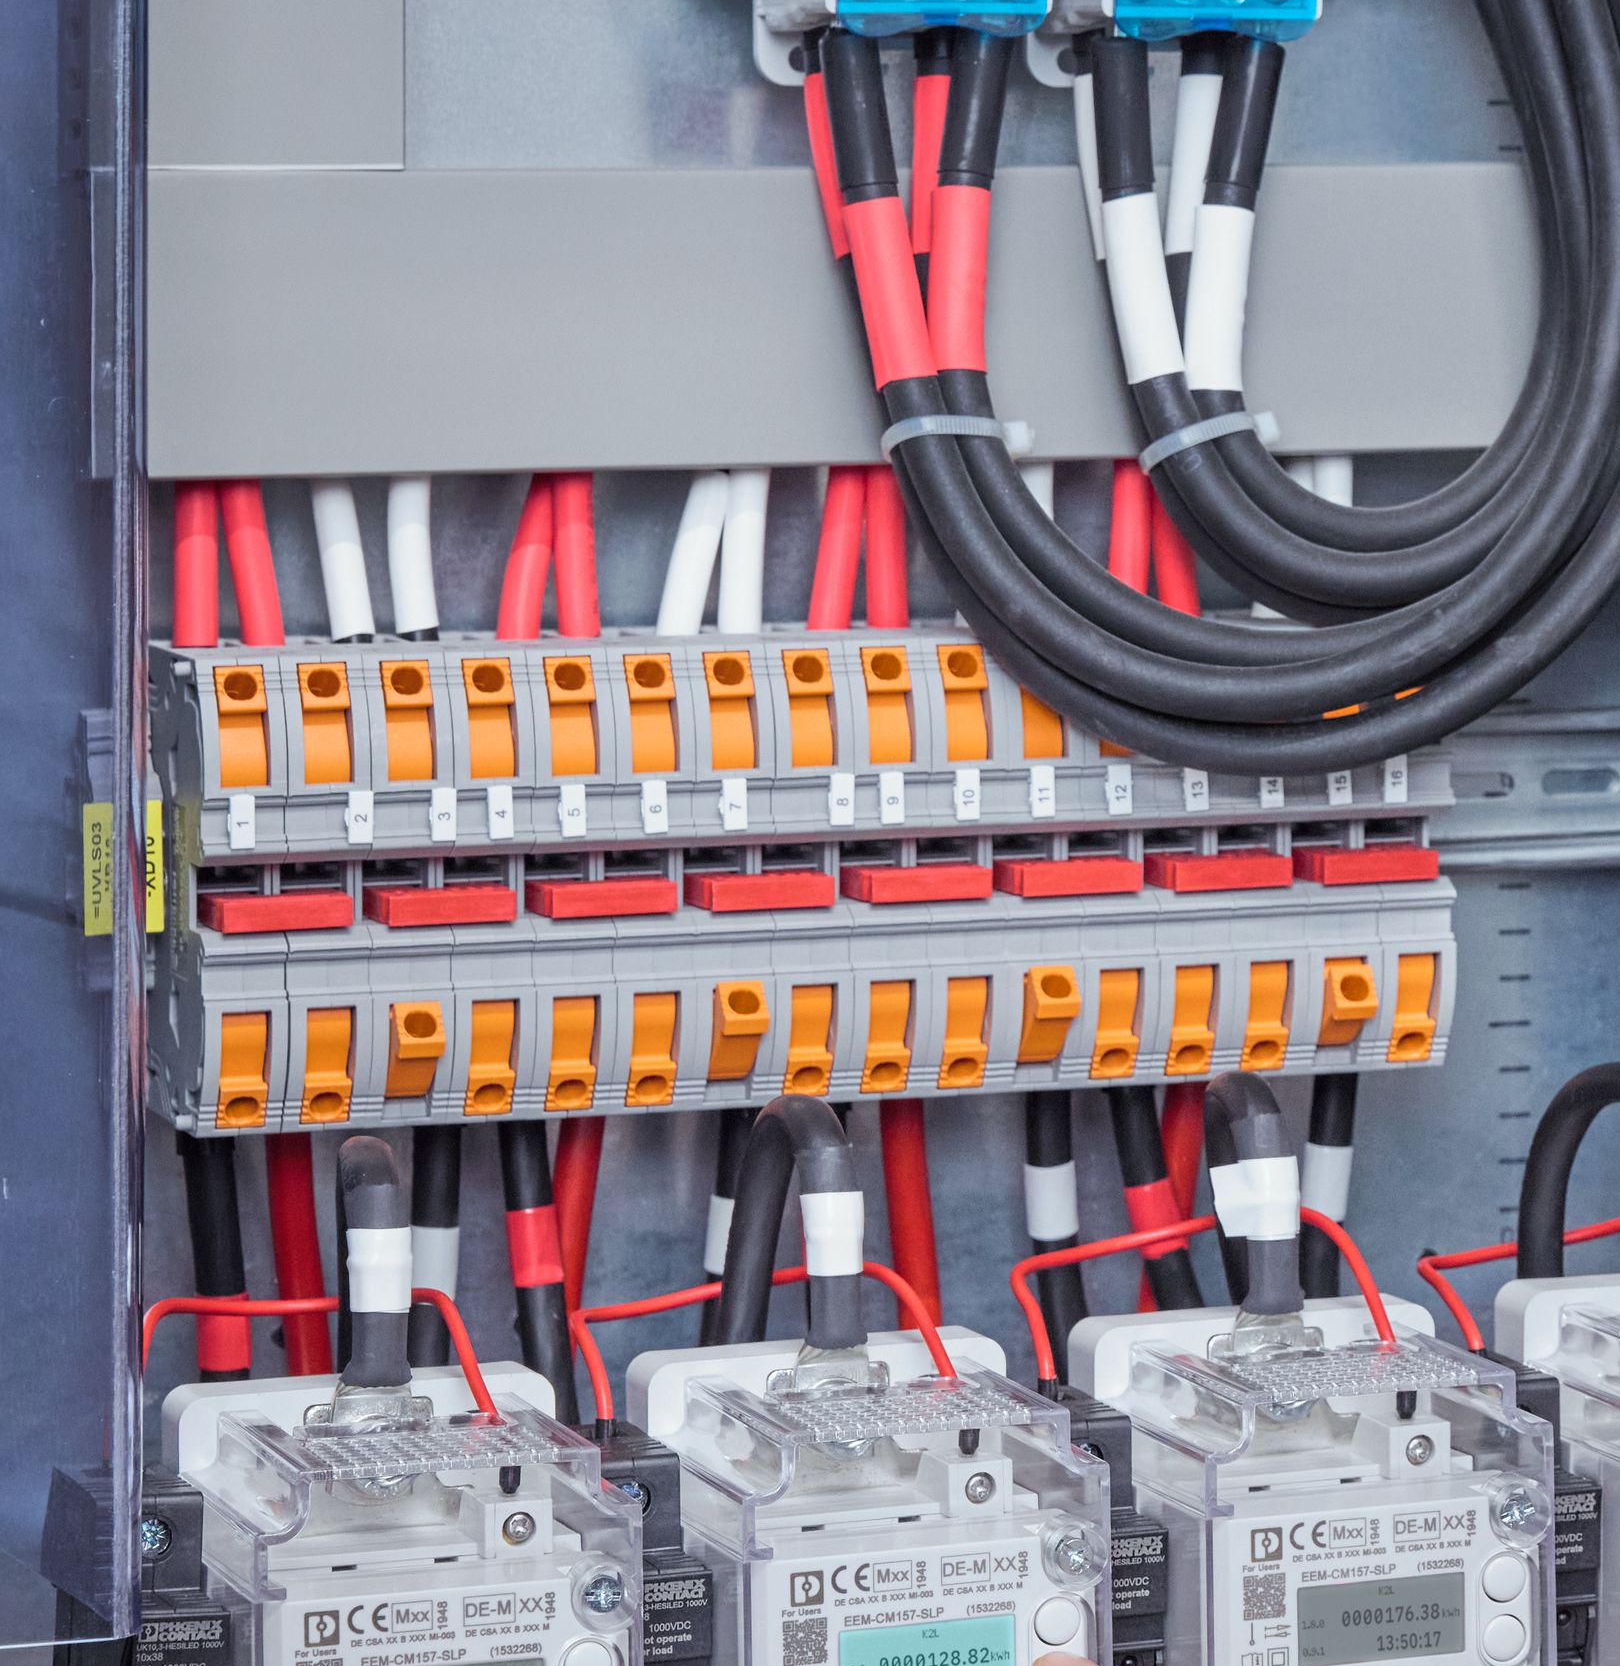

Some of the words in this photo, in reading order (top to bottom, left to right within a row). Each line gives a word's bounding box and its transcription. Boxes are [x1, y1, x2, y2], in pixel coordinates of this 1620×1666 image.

[1268, 778, 1278, 794] 14
[1336, 775, 1348, 793] 15
[1392, 770, 1402, 787] 16
[1040, 786, 1050, 803] 11
[1115, 784, 1127, 801] 12
[1192, 780, 1204, 798] 13
[837, 798, 848, 806] 8
[888, 796, 899, 805] 9
[963, 789, 974, 807] 10
[495, 809, 508, 819] 4
[568, 808, 580, 816] 5
[650, 804, 662, 813] 6
[731, 802, 741, 811] 7
[356, 813, 367, 823] 2
[439, 811, 450, 821] 3
[92, 822, 102, 918] =UVLS03
[1333, 1526, 1363, 1540] Mxx
[1395, 1518, 1437, 1533] DE-M
[877, 1568, 909, 1583] Mxx
[943, 1560, 986, 1577] DE-M
[1301, 1564, 1396, 1582] EEM-CM157-SLP
[1417, 1558, 1464, 1572] (1532268)
[465, 1600, 511, 1618] DE-M
[519, 1597, 543, 1613] XX
[686, 1599, 707, 1607] 1000V
[395, 1609, 429, 1624] Mxx
[437, 1601, 448, 1629] 1948
[845, 1608, 944, 1627] EEM-CM157-SLP
[966, 1602, 1016, 1616] (1532268)
[1342, 1604, 1440, 1627] 0000176.38
[649, 1621, 691, 1632] 1000VDC
[922, 1629, 939, 1638] K2L
[159, 1631, 220, 1641] CONTACT
[657, 1633, 692, 1645] operate
[1377, 1632, 1441, 1651] 13:50:17
[136, 1653, 163, 1661] 10x38
[295, 1650, 309, 1658] For
[313, 1648, 337, 1657] Users
[490, 1643, 542, 1658] (1532268)
[653, 1645, 673, 1655] load
